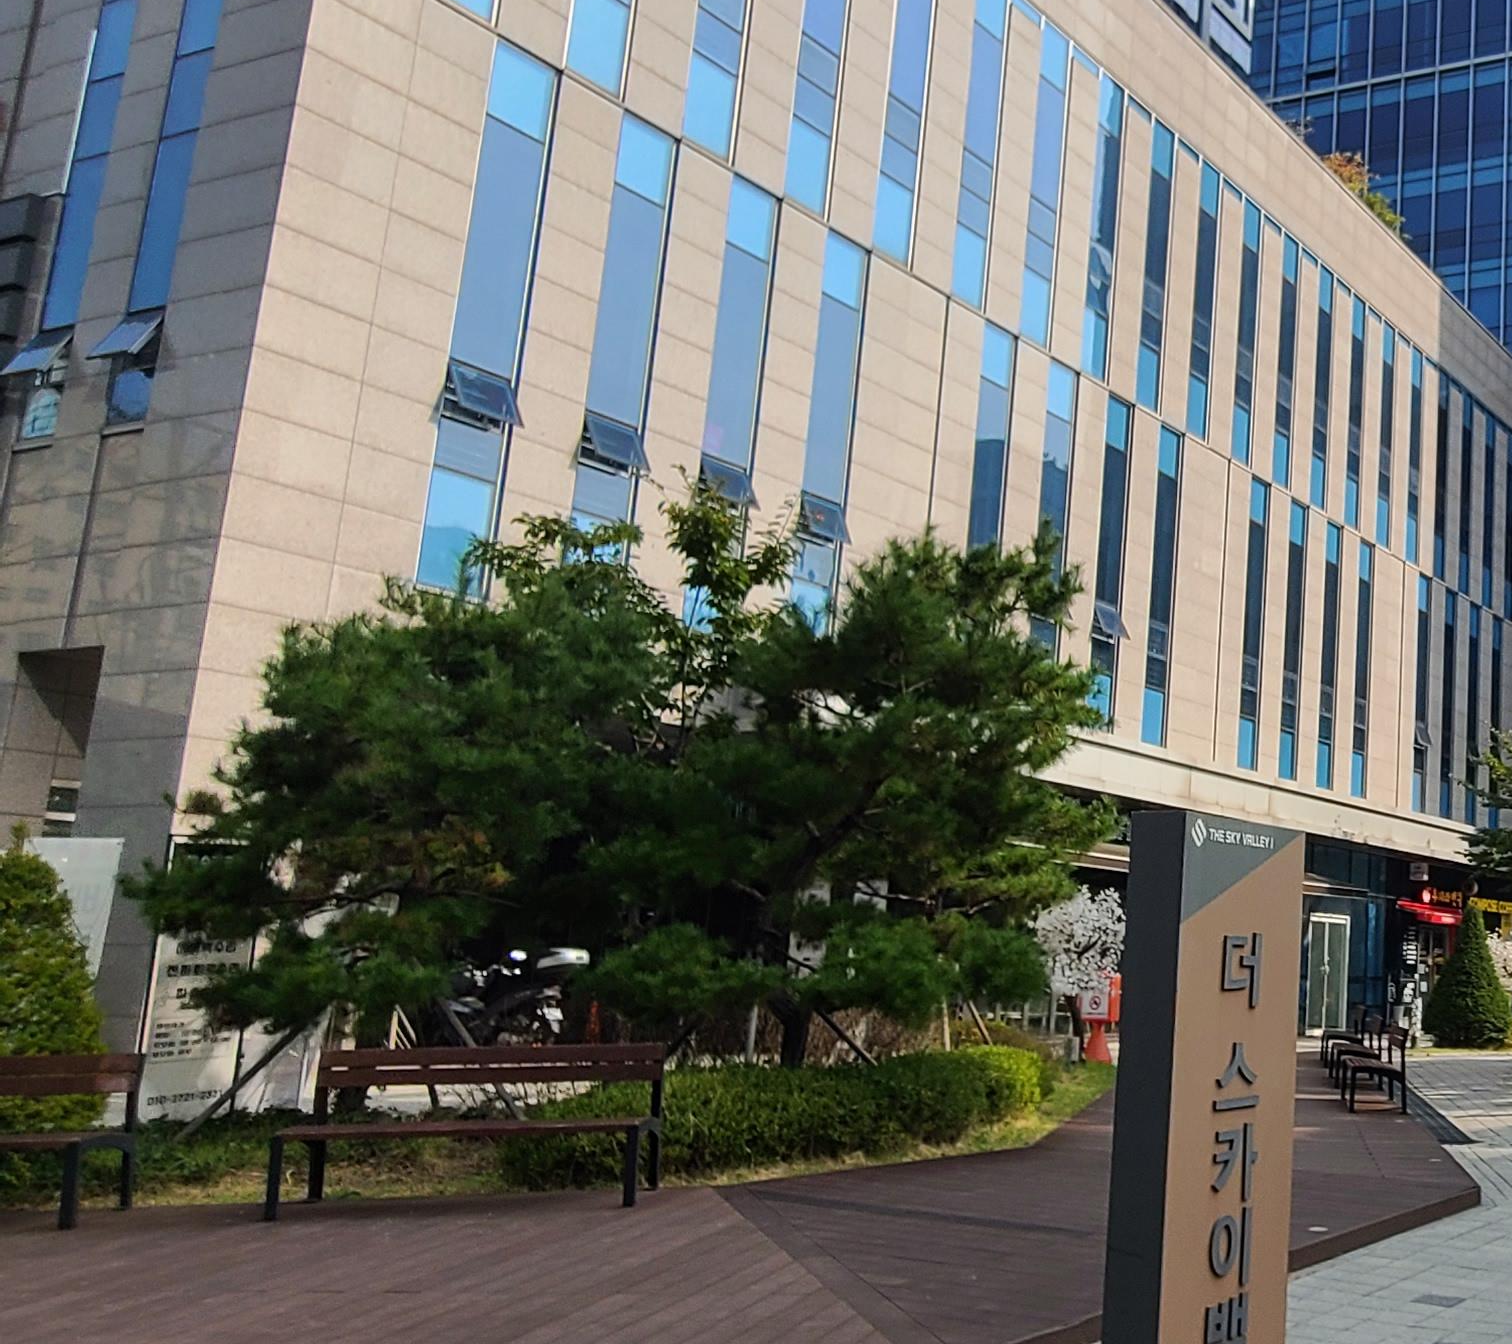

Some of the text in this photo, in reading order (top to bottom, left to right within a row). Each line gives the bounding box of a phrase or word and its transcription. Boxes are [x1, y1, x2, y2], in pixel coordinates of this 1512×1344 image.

[1208, 828, 1225, 843] THE
[1225, 830, 1241, 845] SKY
[1242, 832, 1270, 848] VALLEY
[1220, 930, 1263, 1009] 더
